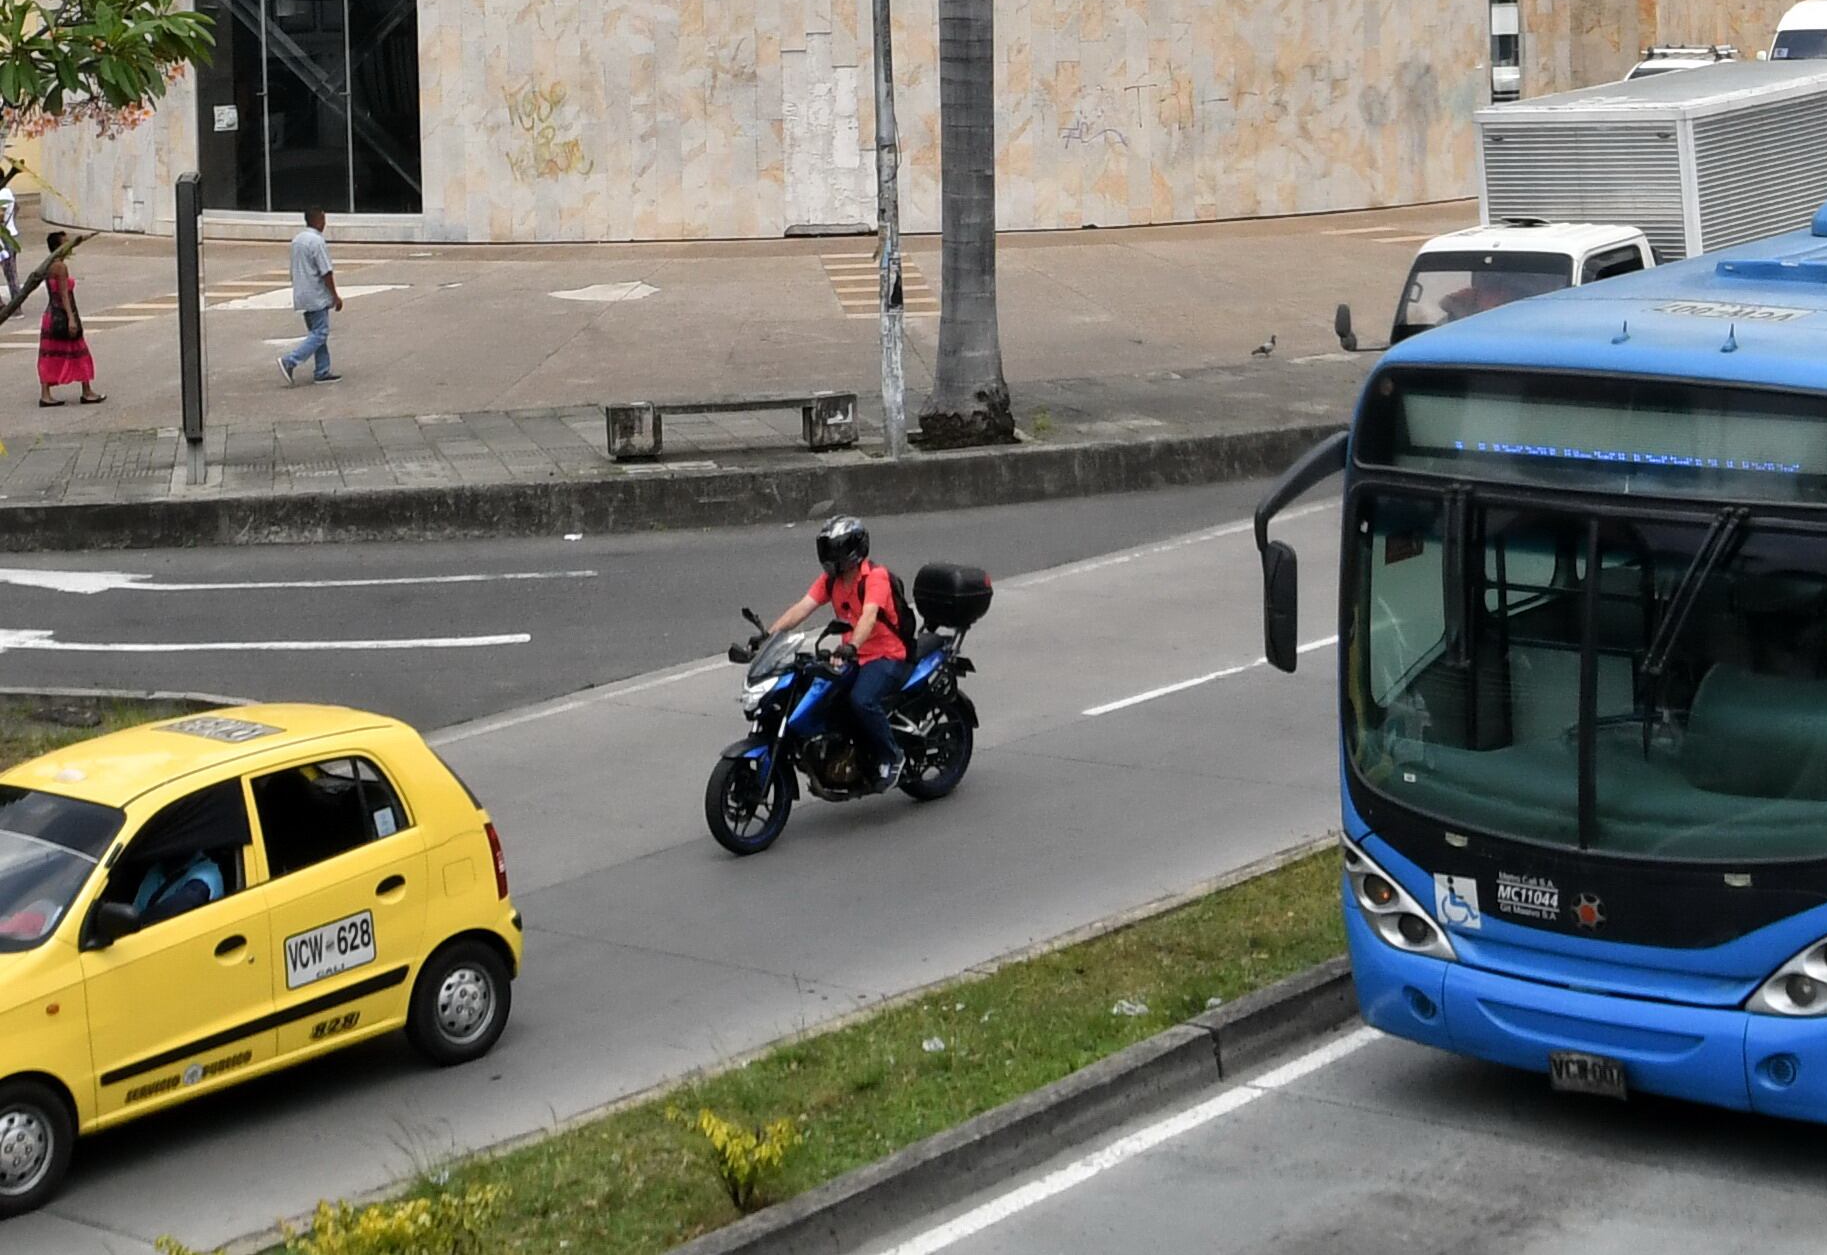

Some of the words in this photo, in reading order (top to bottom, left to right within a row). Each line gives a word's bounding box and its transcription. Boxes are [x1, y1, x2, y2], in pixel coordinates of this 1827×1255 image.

[1497, 884, 1559, 908] MC11044
[287, 932, 323, 973] VCW
[336, 918, 372, 956] 628
